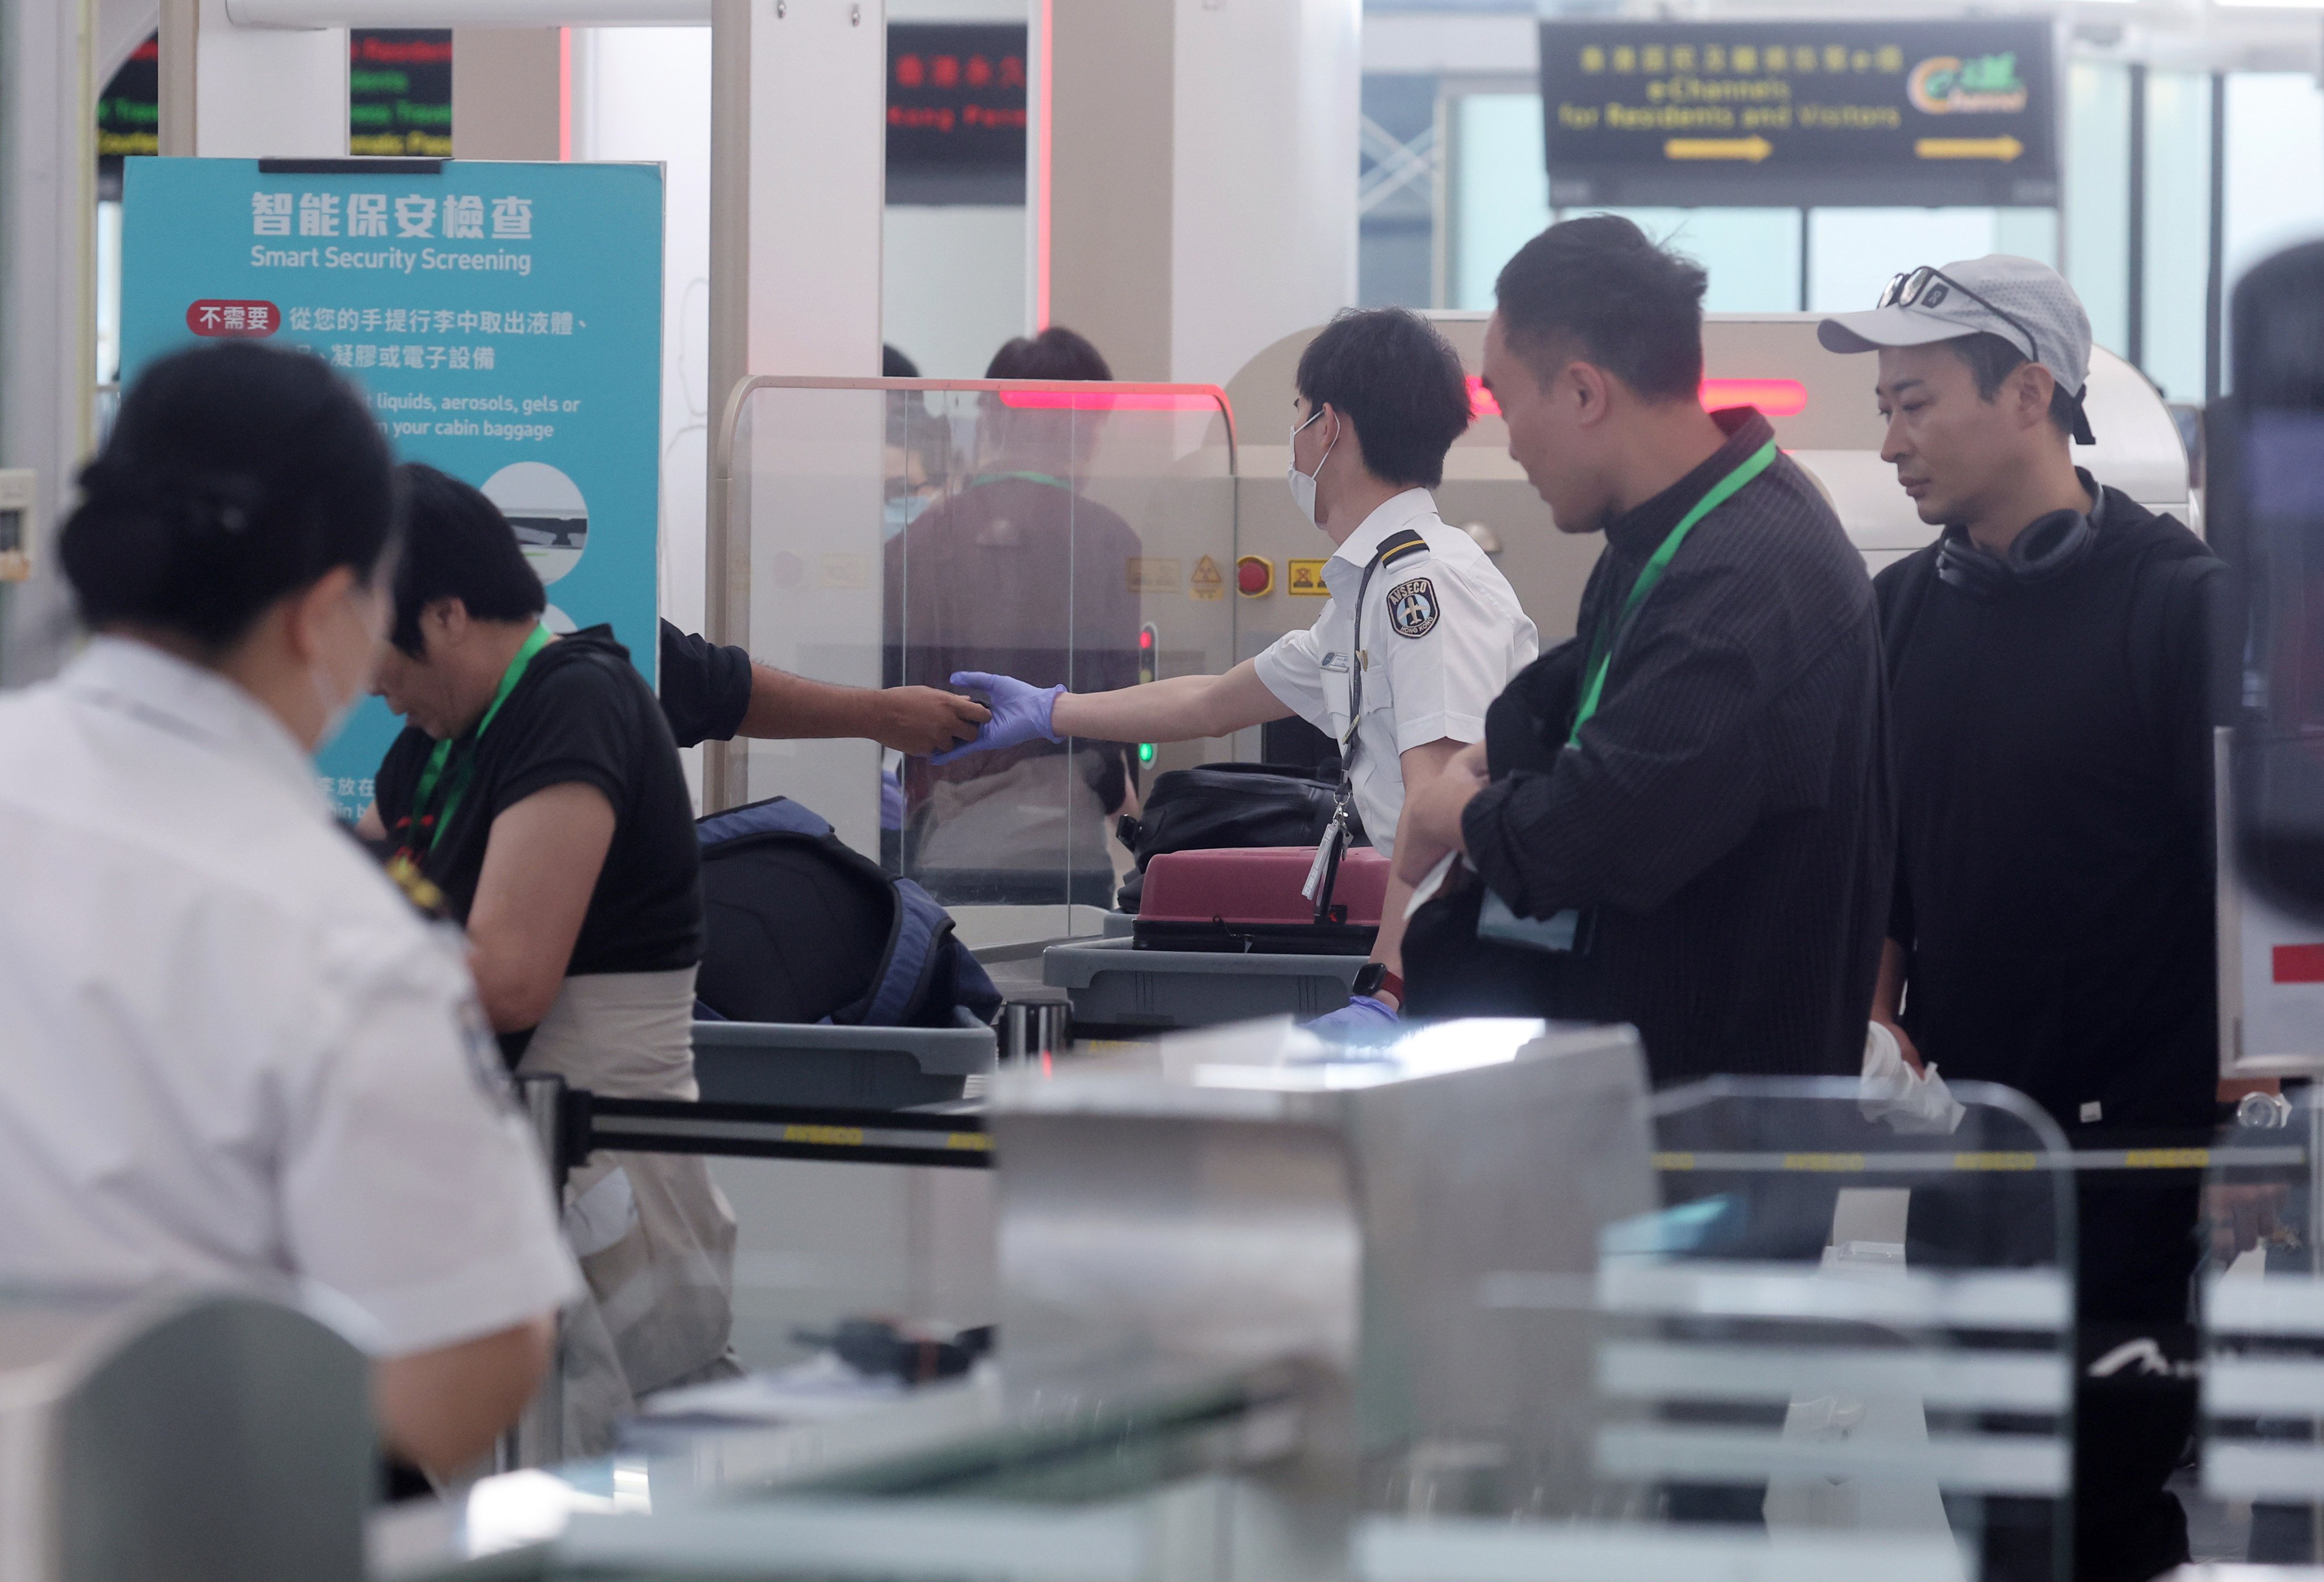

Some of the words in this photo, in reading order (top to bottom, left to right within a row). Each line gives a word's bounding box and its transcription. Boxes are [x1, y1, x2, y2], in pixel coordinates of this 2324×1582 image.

[252, 192, 532, 240] 智能保安檢查
[250, 245, 319, 268] Smart
[325, 246, 417, 274] Security
[421, 248, 532, 276] Screening
[200, 306, 268, 330] 不需要
[377, 392, 437, 413] liquids,
[441, 395, 518, 414] aerosols,
[522, 396, 558, 416] gels
[562, 400, 581, 413] or
[393, 422, 430, 439] your
[435, 419, 479, 436] cabin
[484, 421, 554, 441] baggage
[1389, 581, 1427, 606] AVSECO
[1418, 616, 1434, 632] KONG
